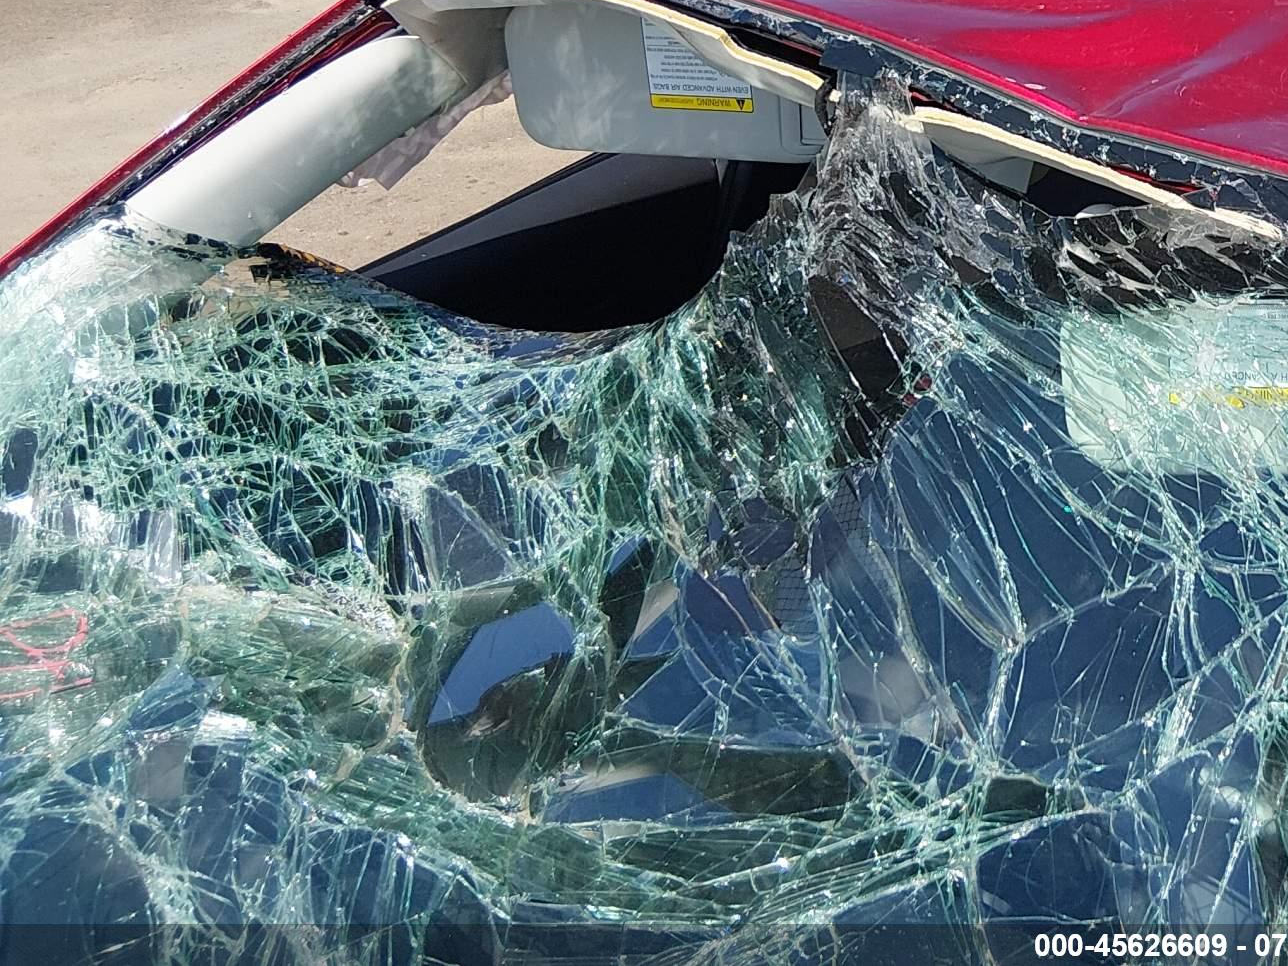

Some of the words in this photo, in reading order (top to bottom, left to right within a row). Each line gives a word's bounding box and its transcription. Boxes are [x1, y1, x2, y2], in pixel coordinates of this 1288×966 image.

[682, 84, 715, 93] ADVANCED
[716, 85, 732, 93] WITH
[733, 86, 749, 94] EVEN
[697, 98, 731, 107] WARNING
